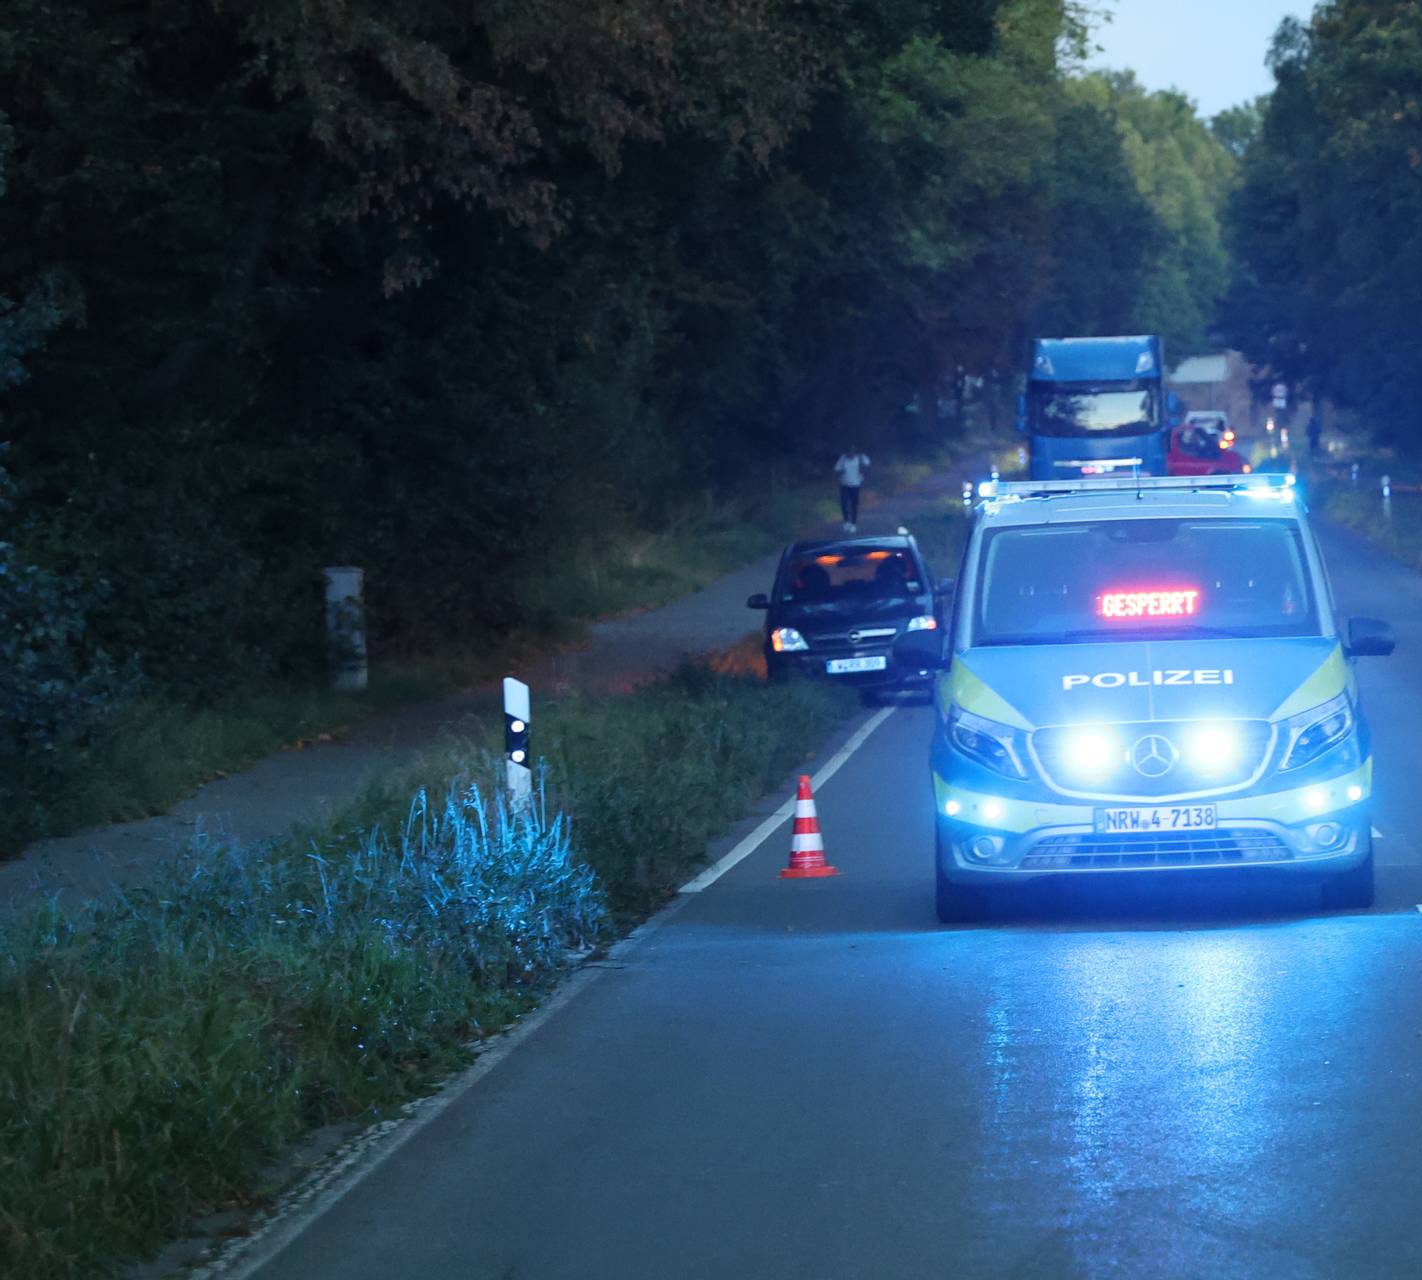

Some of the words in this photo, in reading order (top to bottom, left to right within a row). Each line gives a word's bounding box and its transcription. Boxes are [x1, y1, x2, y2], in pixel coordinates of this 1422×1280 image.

[1102, 591, 1198, 616] GESPERRT
[1062, 669, 1235, 691] POLIZEI
[1105, 810, 1140, 830] NRW
